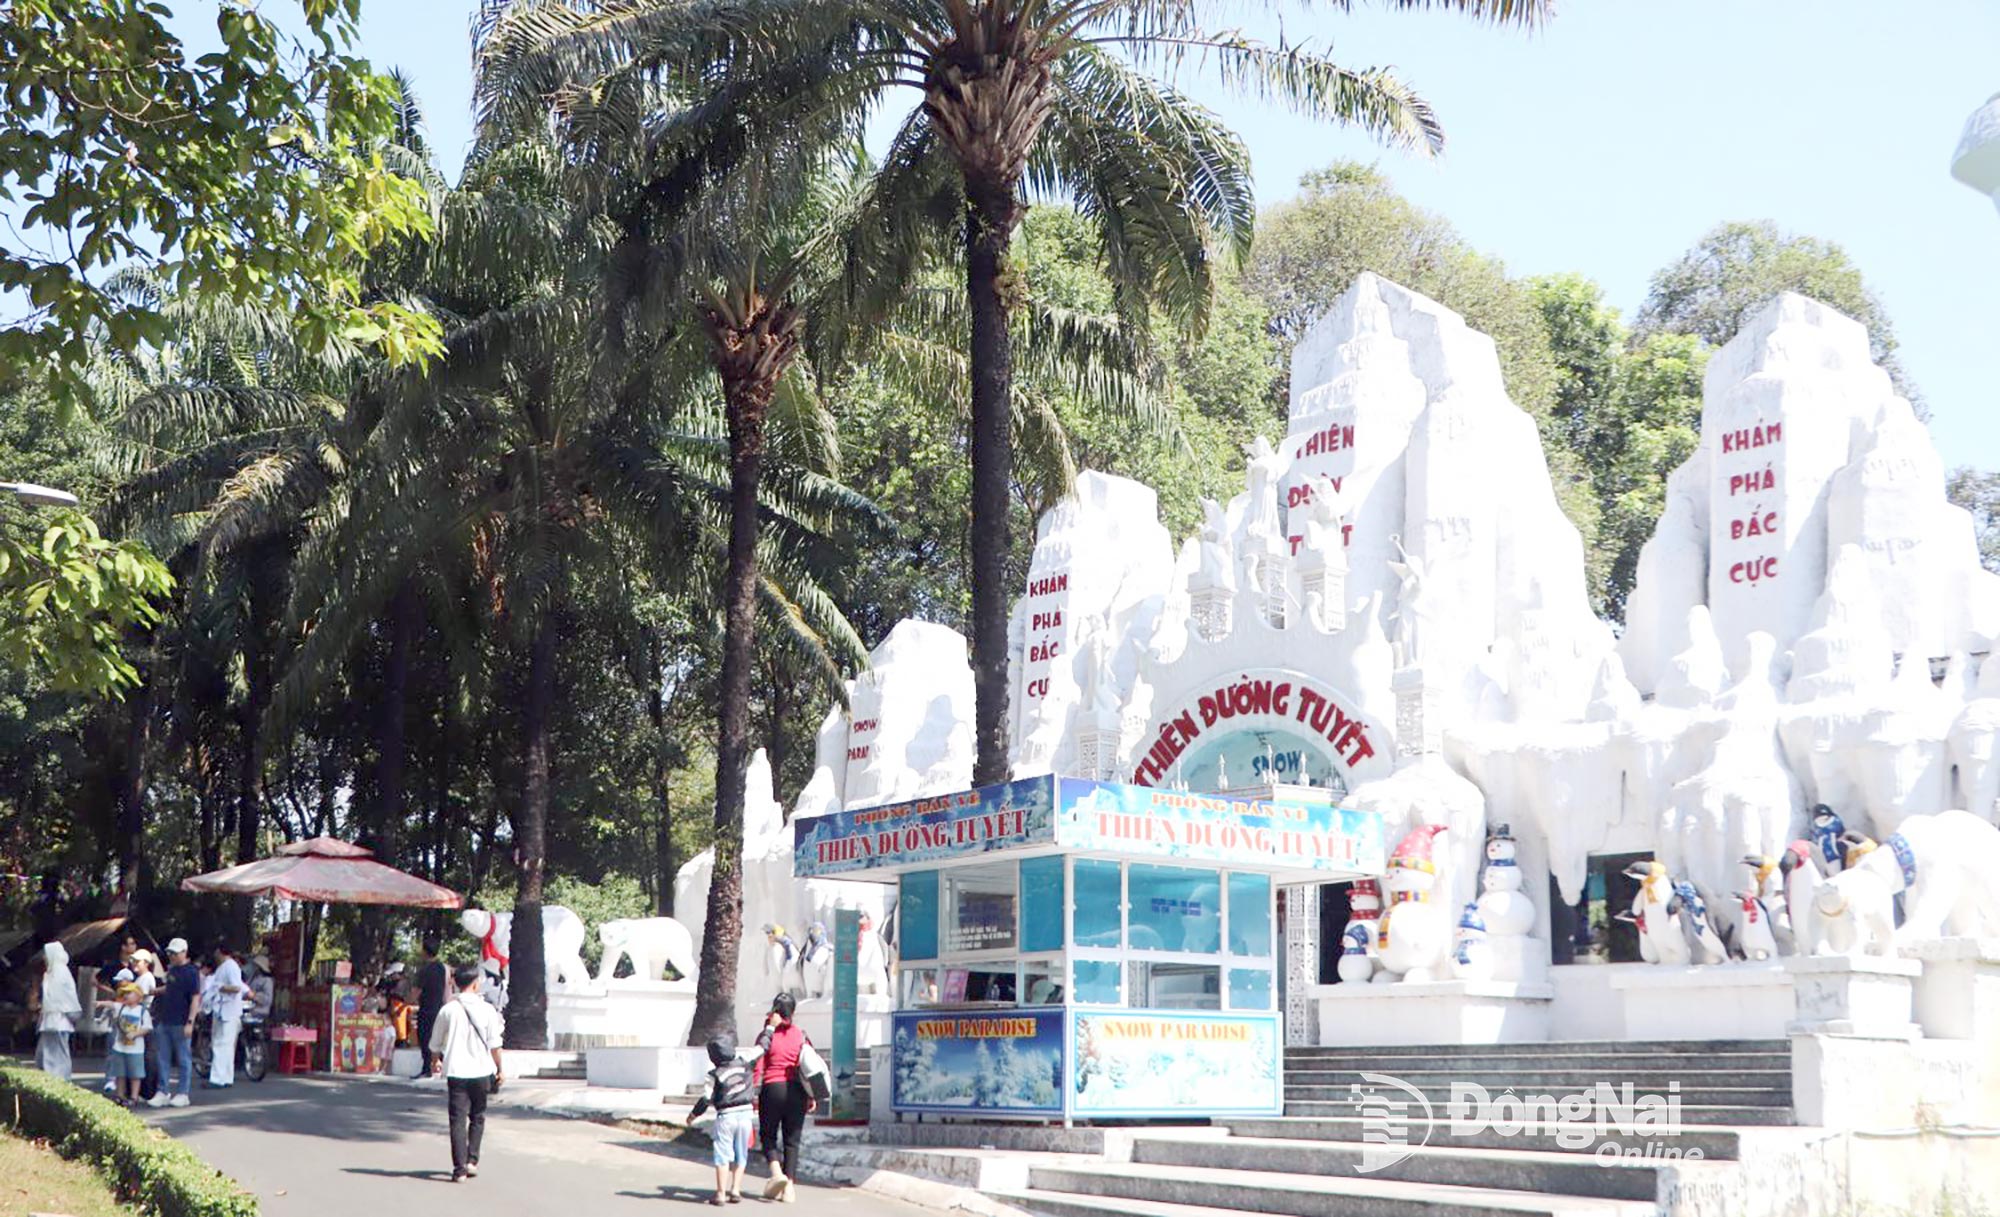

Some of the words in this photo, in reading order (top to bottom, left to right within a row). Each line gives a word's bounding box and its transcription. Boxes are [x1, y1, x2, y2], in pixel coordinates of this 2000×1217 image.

[1296, 422, 1355, 460] HIÊN
[1722, 418, 1782, 453] KHÁM
[1730, 461, 1775, 496] PHÁ
[1731, 504, 1777, 539] BẮC
[1030, 571, 1068, 597] KHÁM
[1729, 555, 1778, 587] CỰC
[1032, 603, 1062, 631] PHÁ
[1030, 634, 1059, 662] BẮC
[1027, 677, 1050, 701] CỰ
[1130, 709, 1201, 788] THIÊN
[1198, 674, 1292, 728] ĐƯỜNG
[1296, 686, 1376, 769] TUYẾT
[1252, 750, 1302, 777] SNOW
[815, 829, 873, 865] THIÊN
[954, 800, 1027, 844] TUYẾT
[1093, 811, 1177, 843] THIÊN
[1279, 826, 1357, 861] TUYẾT
[917, 1020, 956, 1039] SNOW
[958, 1017, 1037, 1038] PARADISE
[1103, 1020, 1156, 1039] SNOW
[1160, 1022, 1251, 1041] PARADISE
